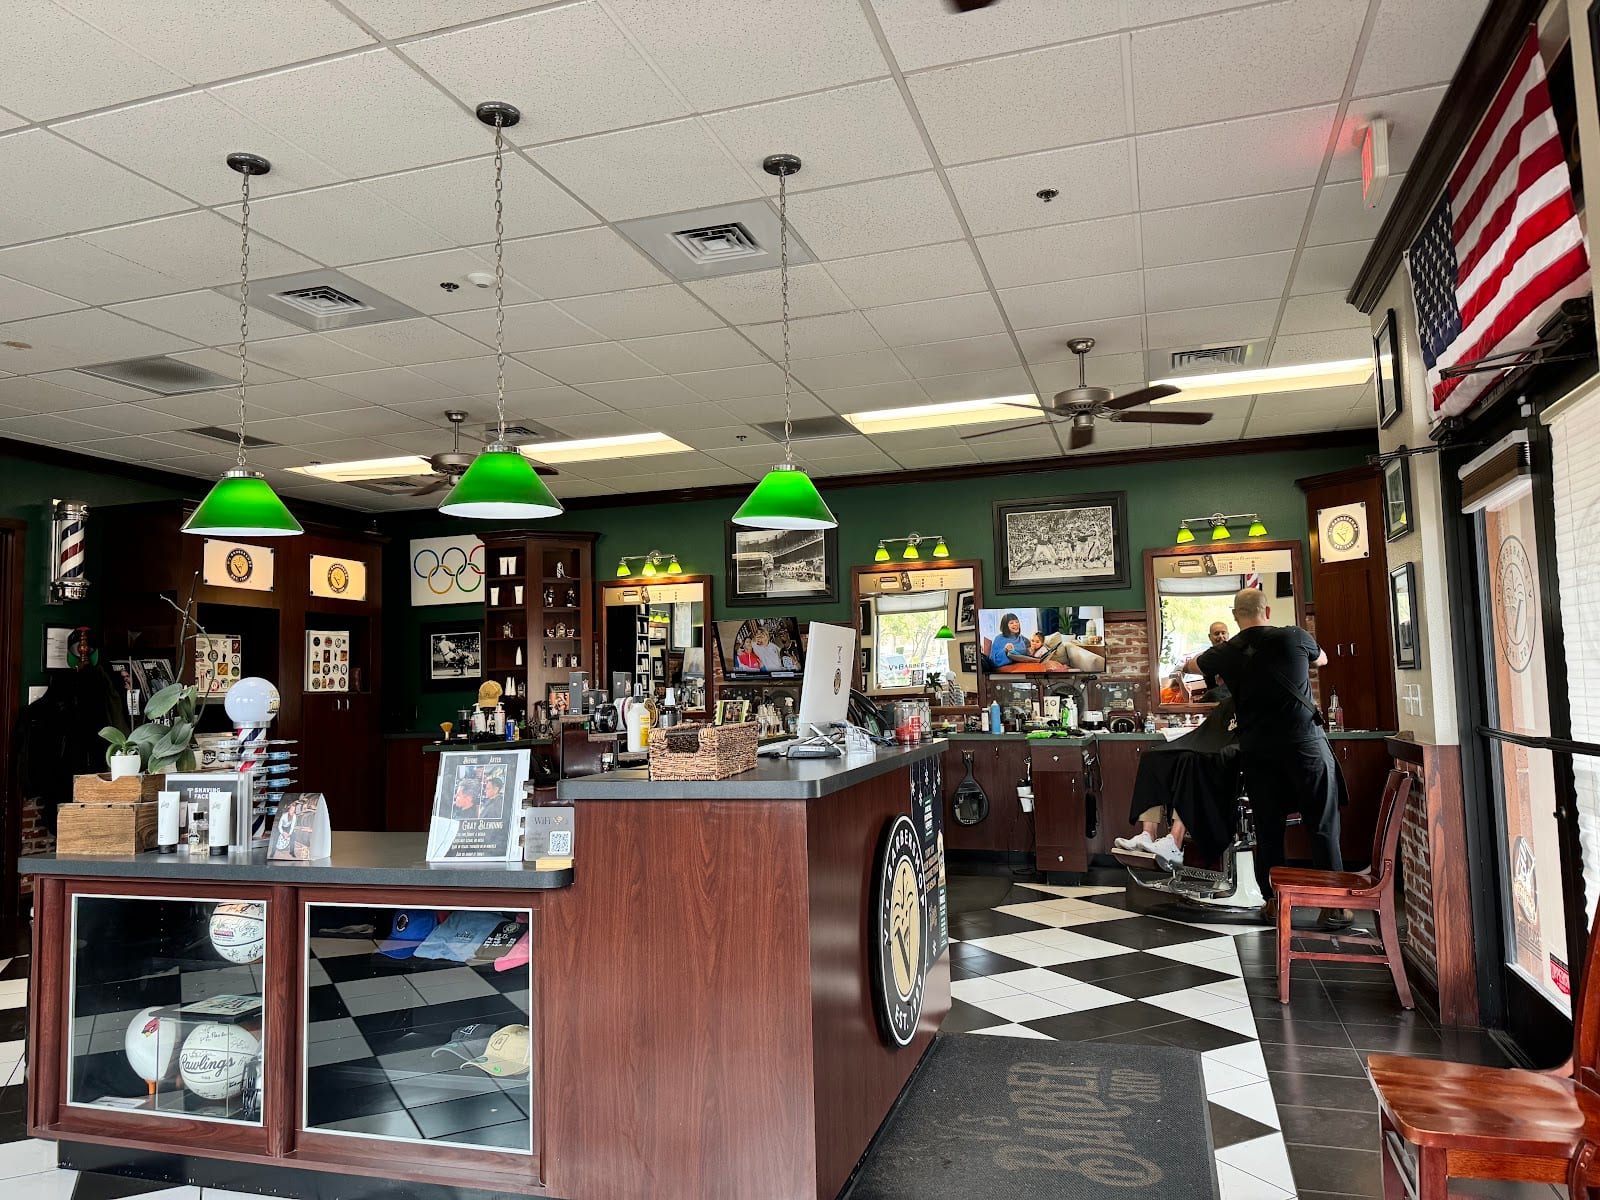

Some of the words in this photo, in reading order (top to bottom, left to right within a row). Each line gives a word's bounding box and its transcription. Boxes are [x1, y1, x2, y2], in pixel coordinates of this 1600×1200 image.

[886, 829, 926, 907] BARBERSHOP
[894, 1005, 910, 1031] EST.
[909, 974, 923, 1022] 1999
[181, 1053, 236, 1078] Rawlings
